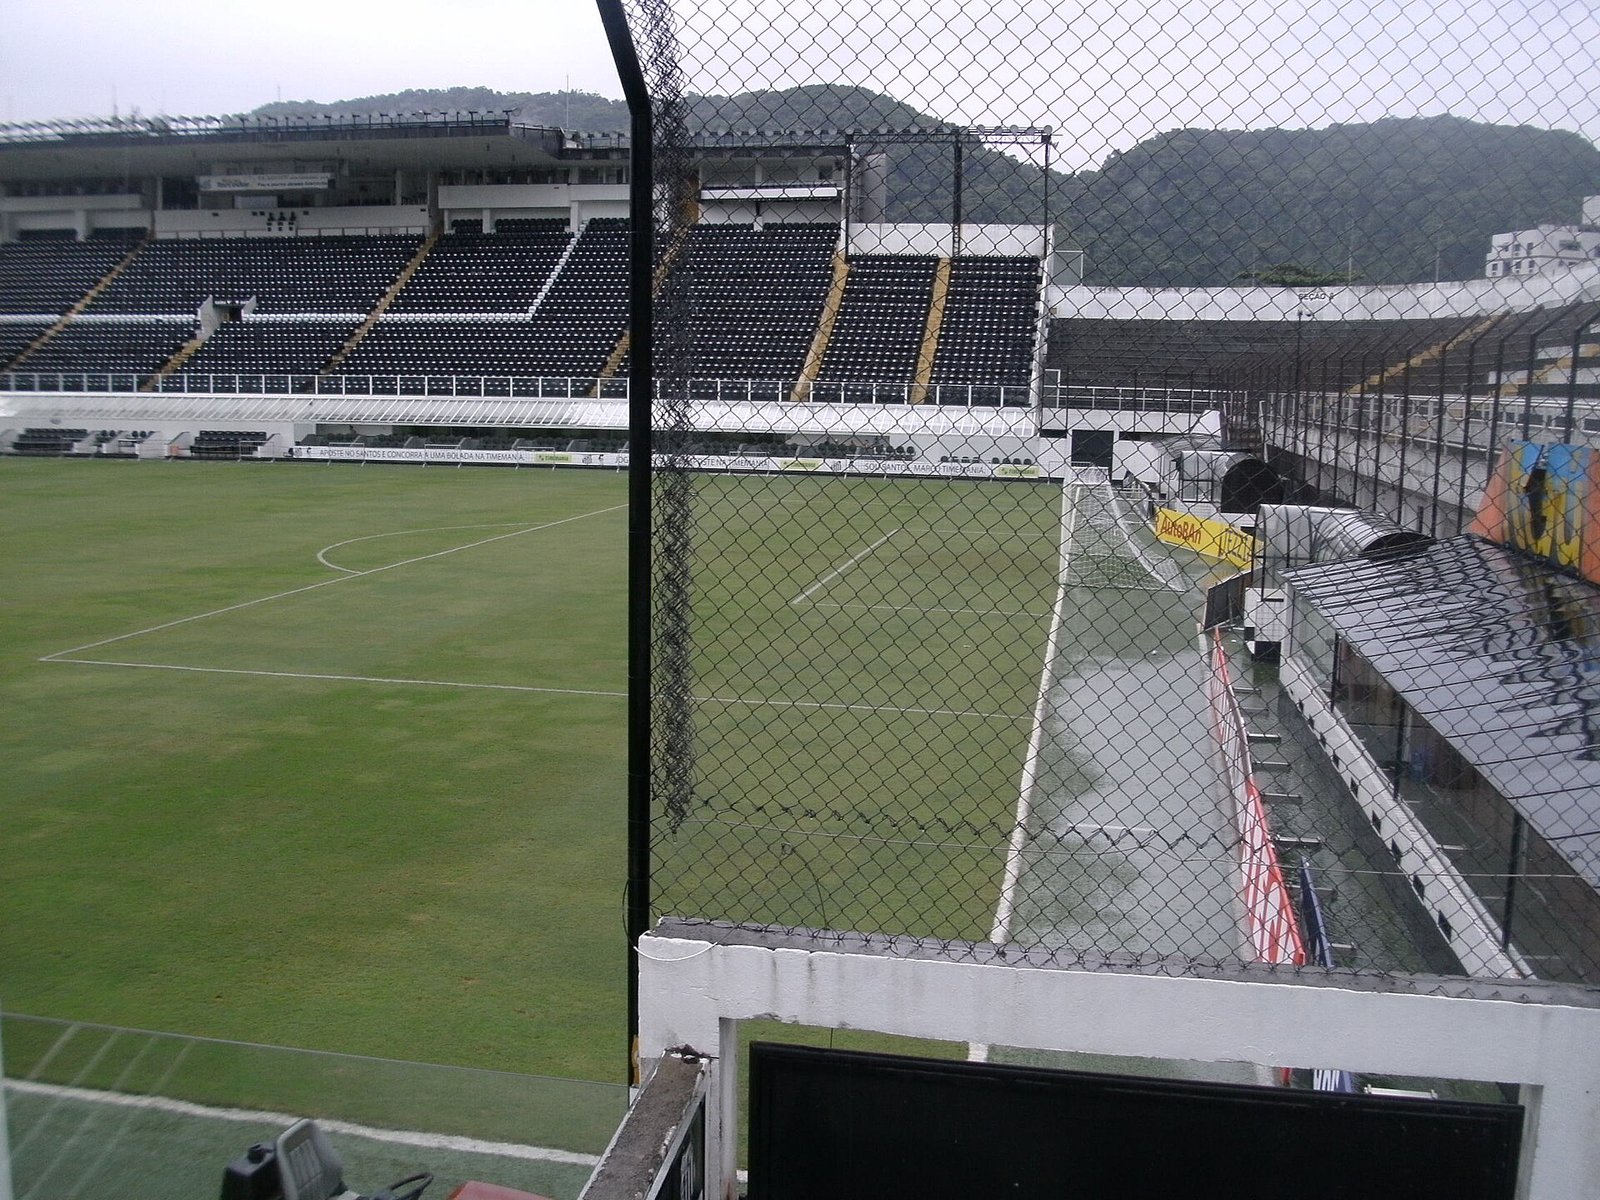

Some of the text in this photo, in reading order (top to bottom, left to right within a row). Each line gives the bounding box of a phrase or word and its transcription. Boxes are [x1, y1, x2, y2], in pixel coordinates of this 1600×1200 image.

[320, 449, 344, 457] APOSTE
[356, 450, 381, 458] SANTOS
[387, 451, 422, 459] CONCORRA
[430, 452, 445, 460] UMA
